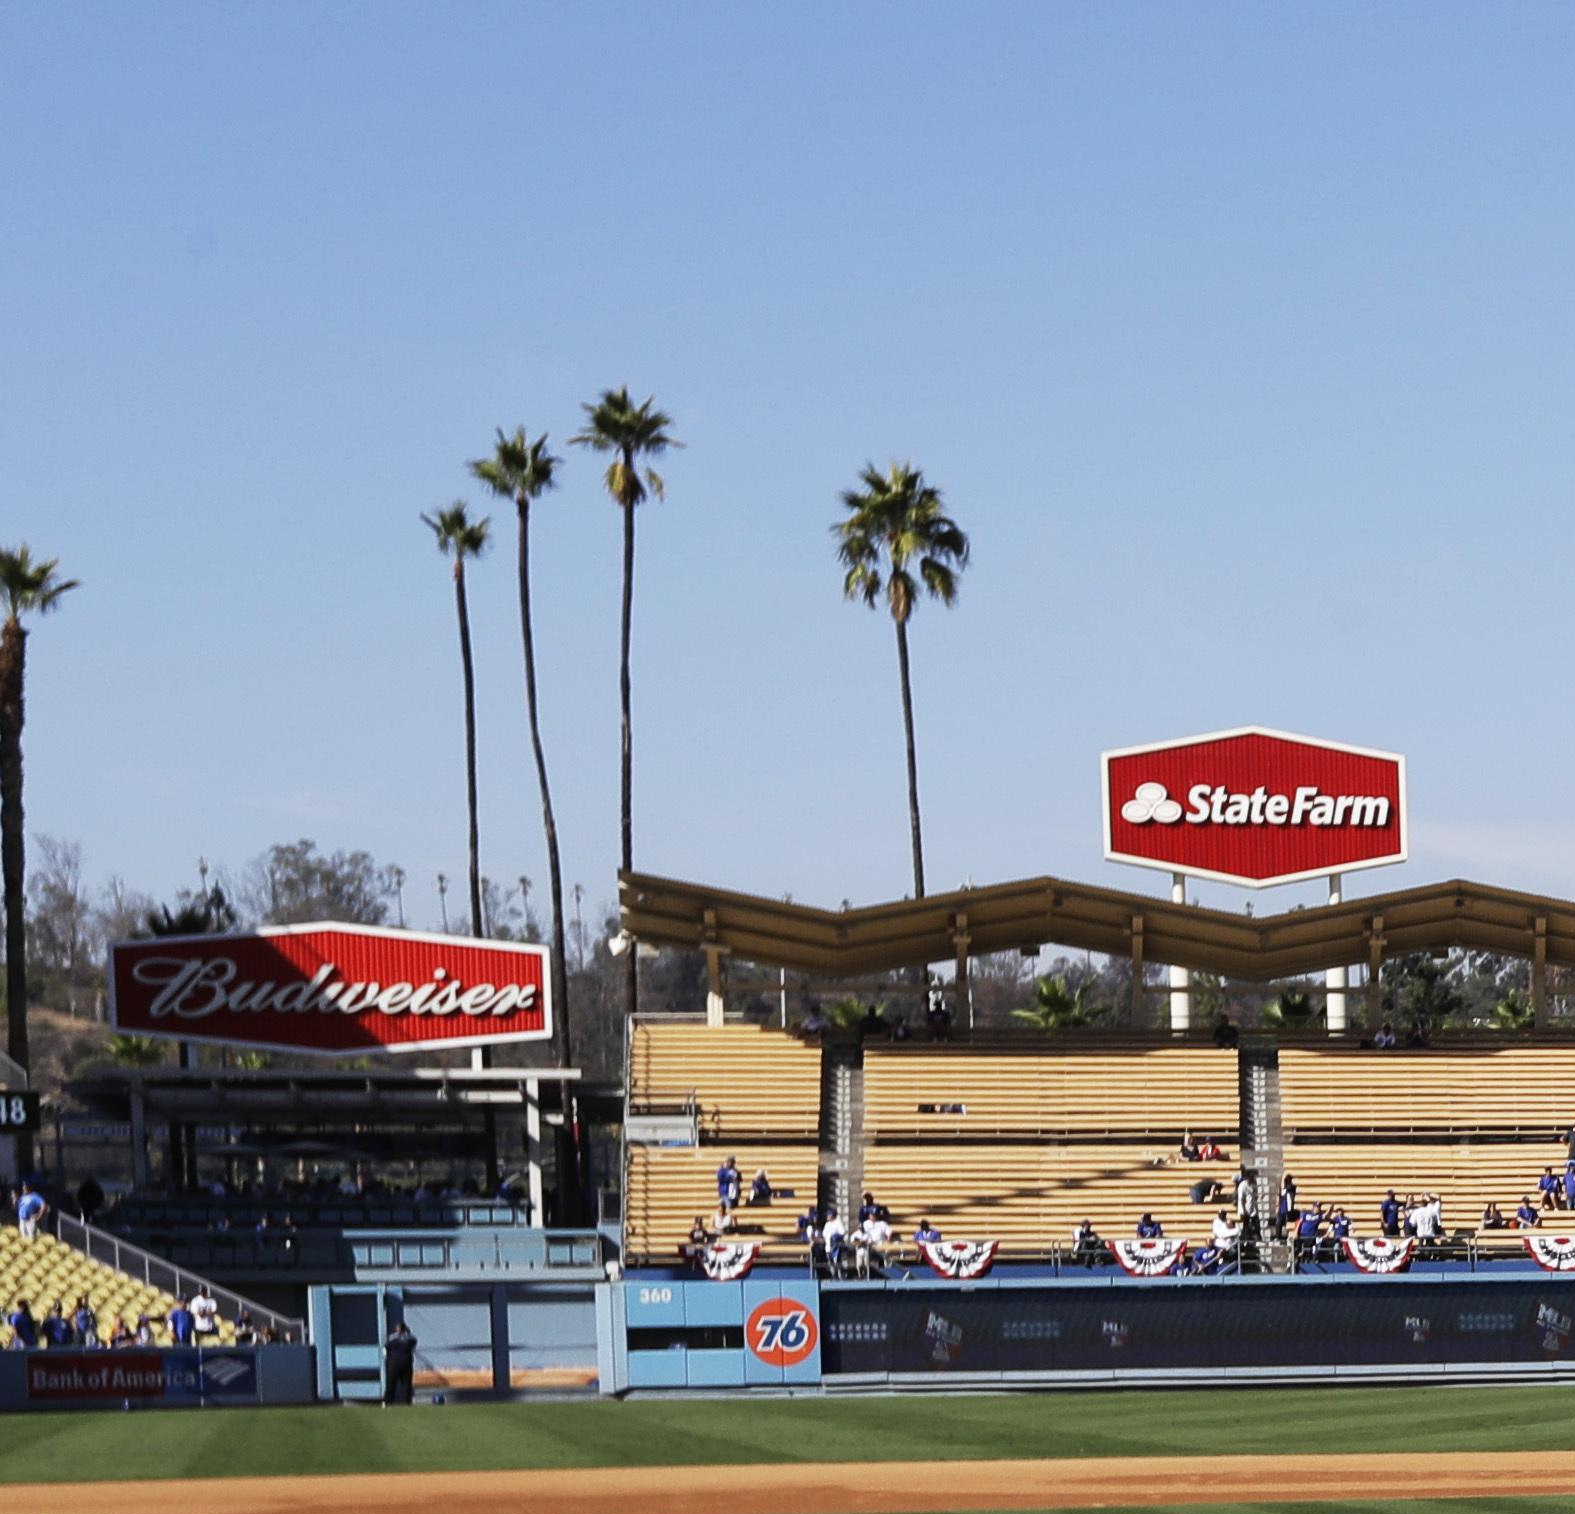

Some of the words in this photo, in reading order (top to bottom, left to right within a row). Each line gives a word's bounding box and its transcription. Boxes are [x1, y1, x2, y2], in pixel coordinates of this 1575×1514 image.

[132, 956, 537, 1019] Budweiser
[640, 1288, 672, 1304] 360
[756, 1310, 809, 1353] 76
[33, 1368, 85, 1390] Bank
[88, 1366, 109, 1388] of
[112, 1367, 196, 1389] America
